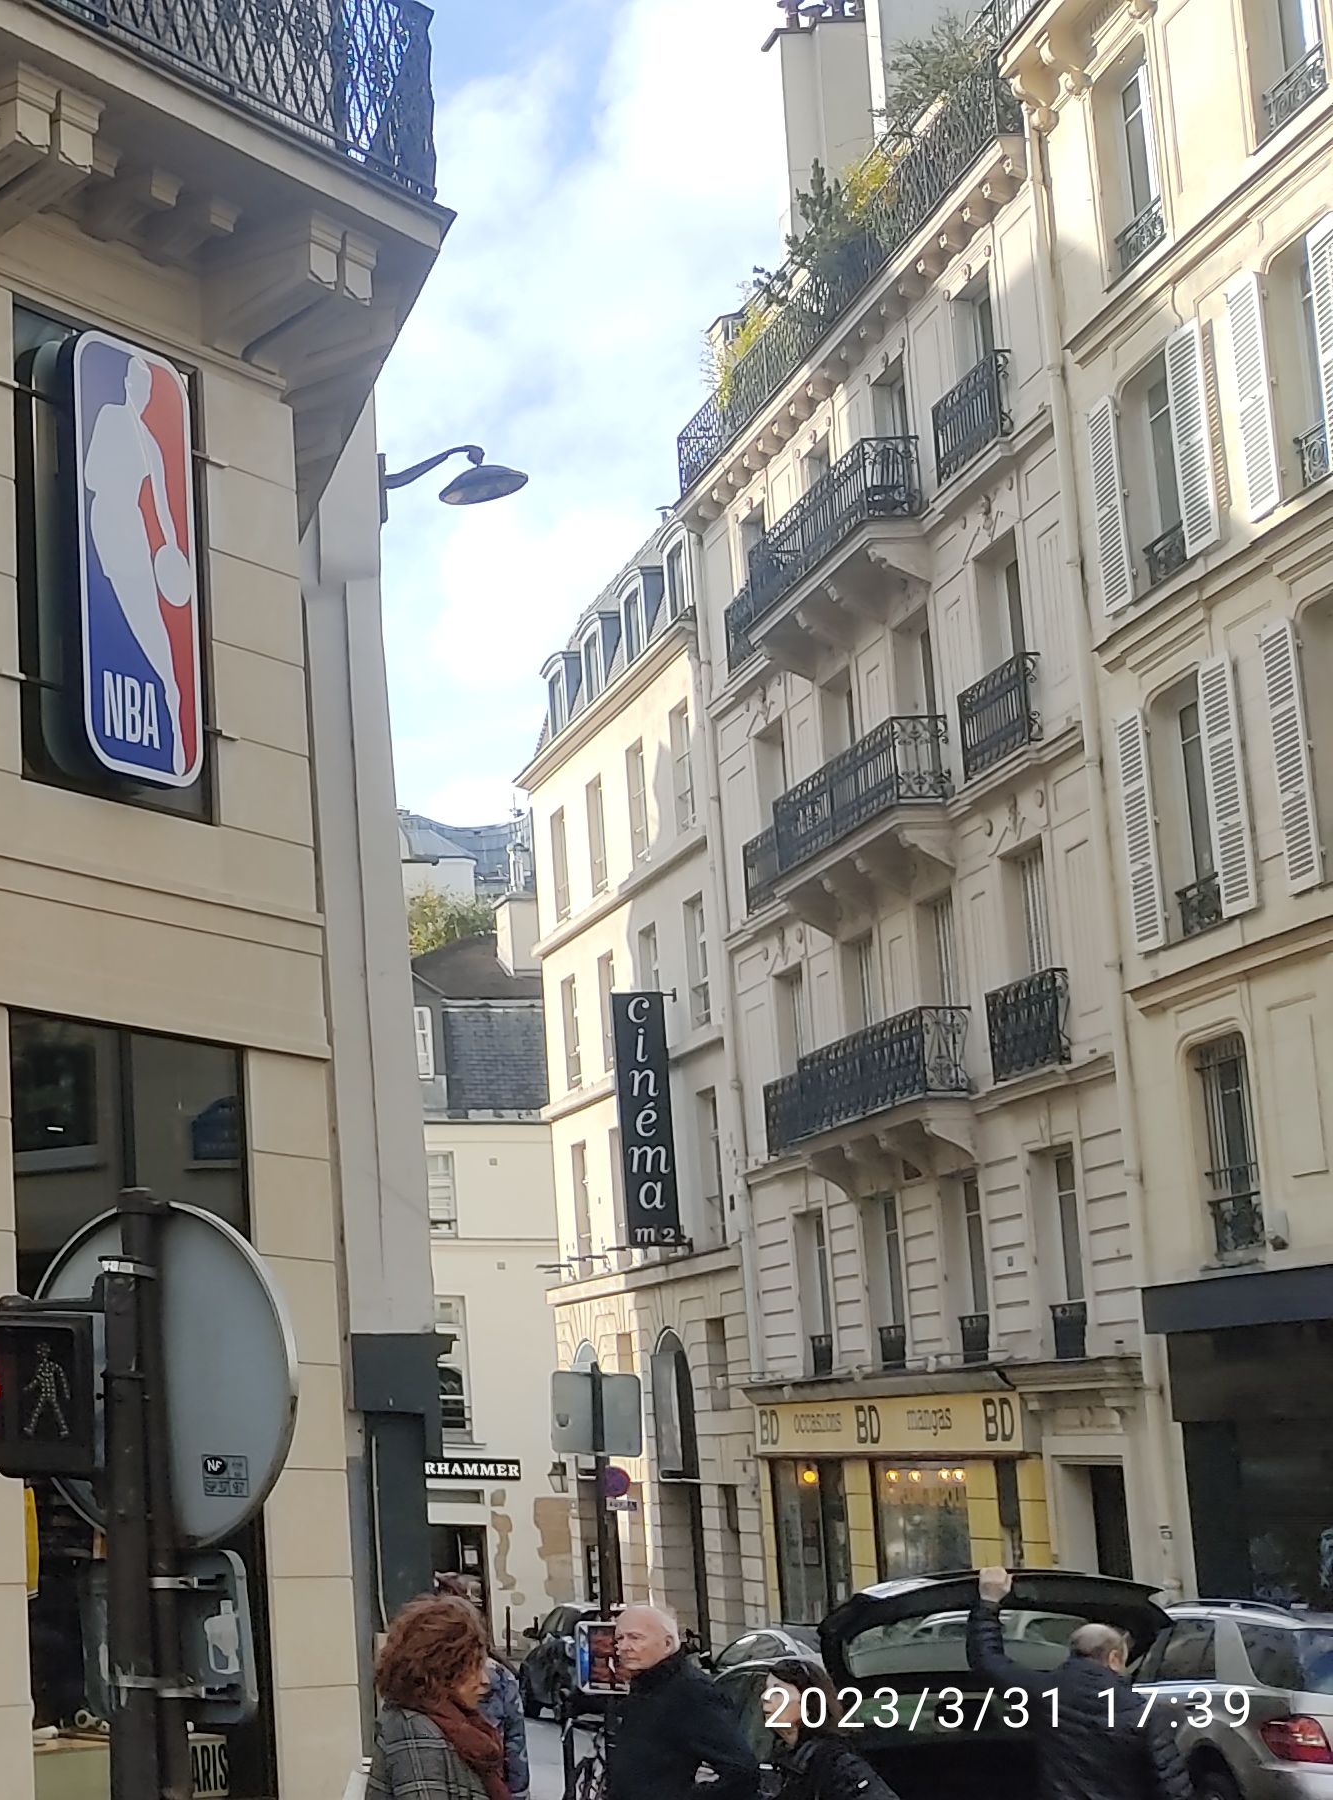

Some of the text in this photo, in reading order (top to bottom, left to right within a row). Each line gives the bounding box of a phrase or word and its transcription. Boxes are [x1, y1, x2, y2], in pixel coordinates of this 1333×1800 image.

[102, 669, 161, 750] NBA
[626, 996, 672, 1211] cinéma
[758, 1409, 780, 1445] BD
[854, 1404, 881, 1444] BD
[906, 1407, 952, 1436] mangas
[982, 1397, 1015, 1442] BD
